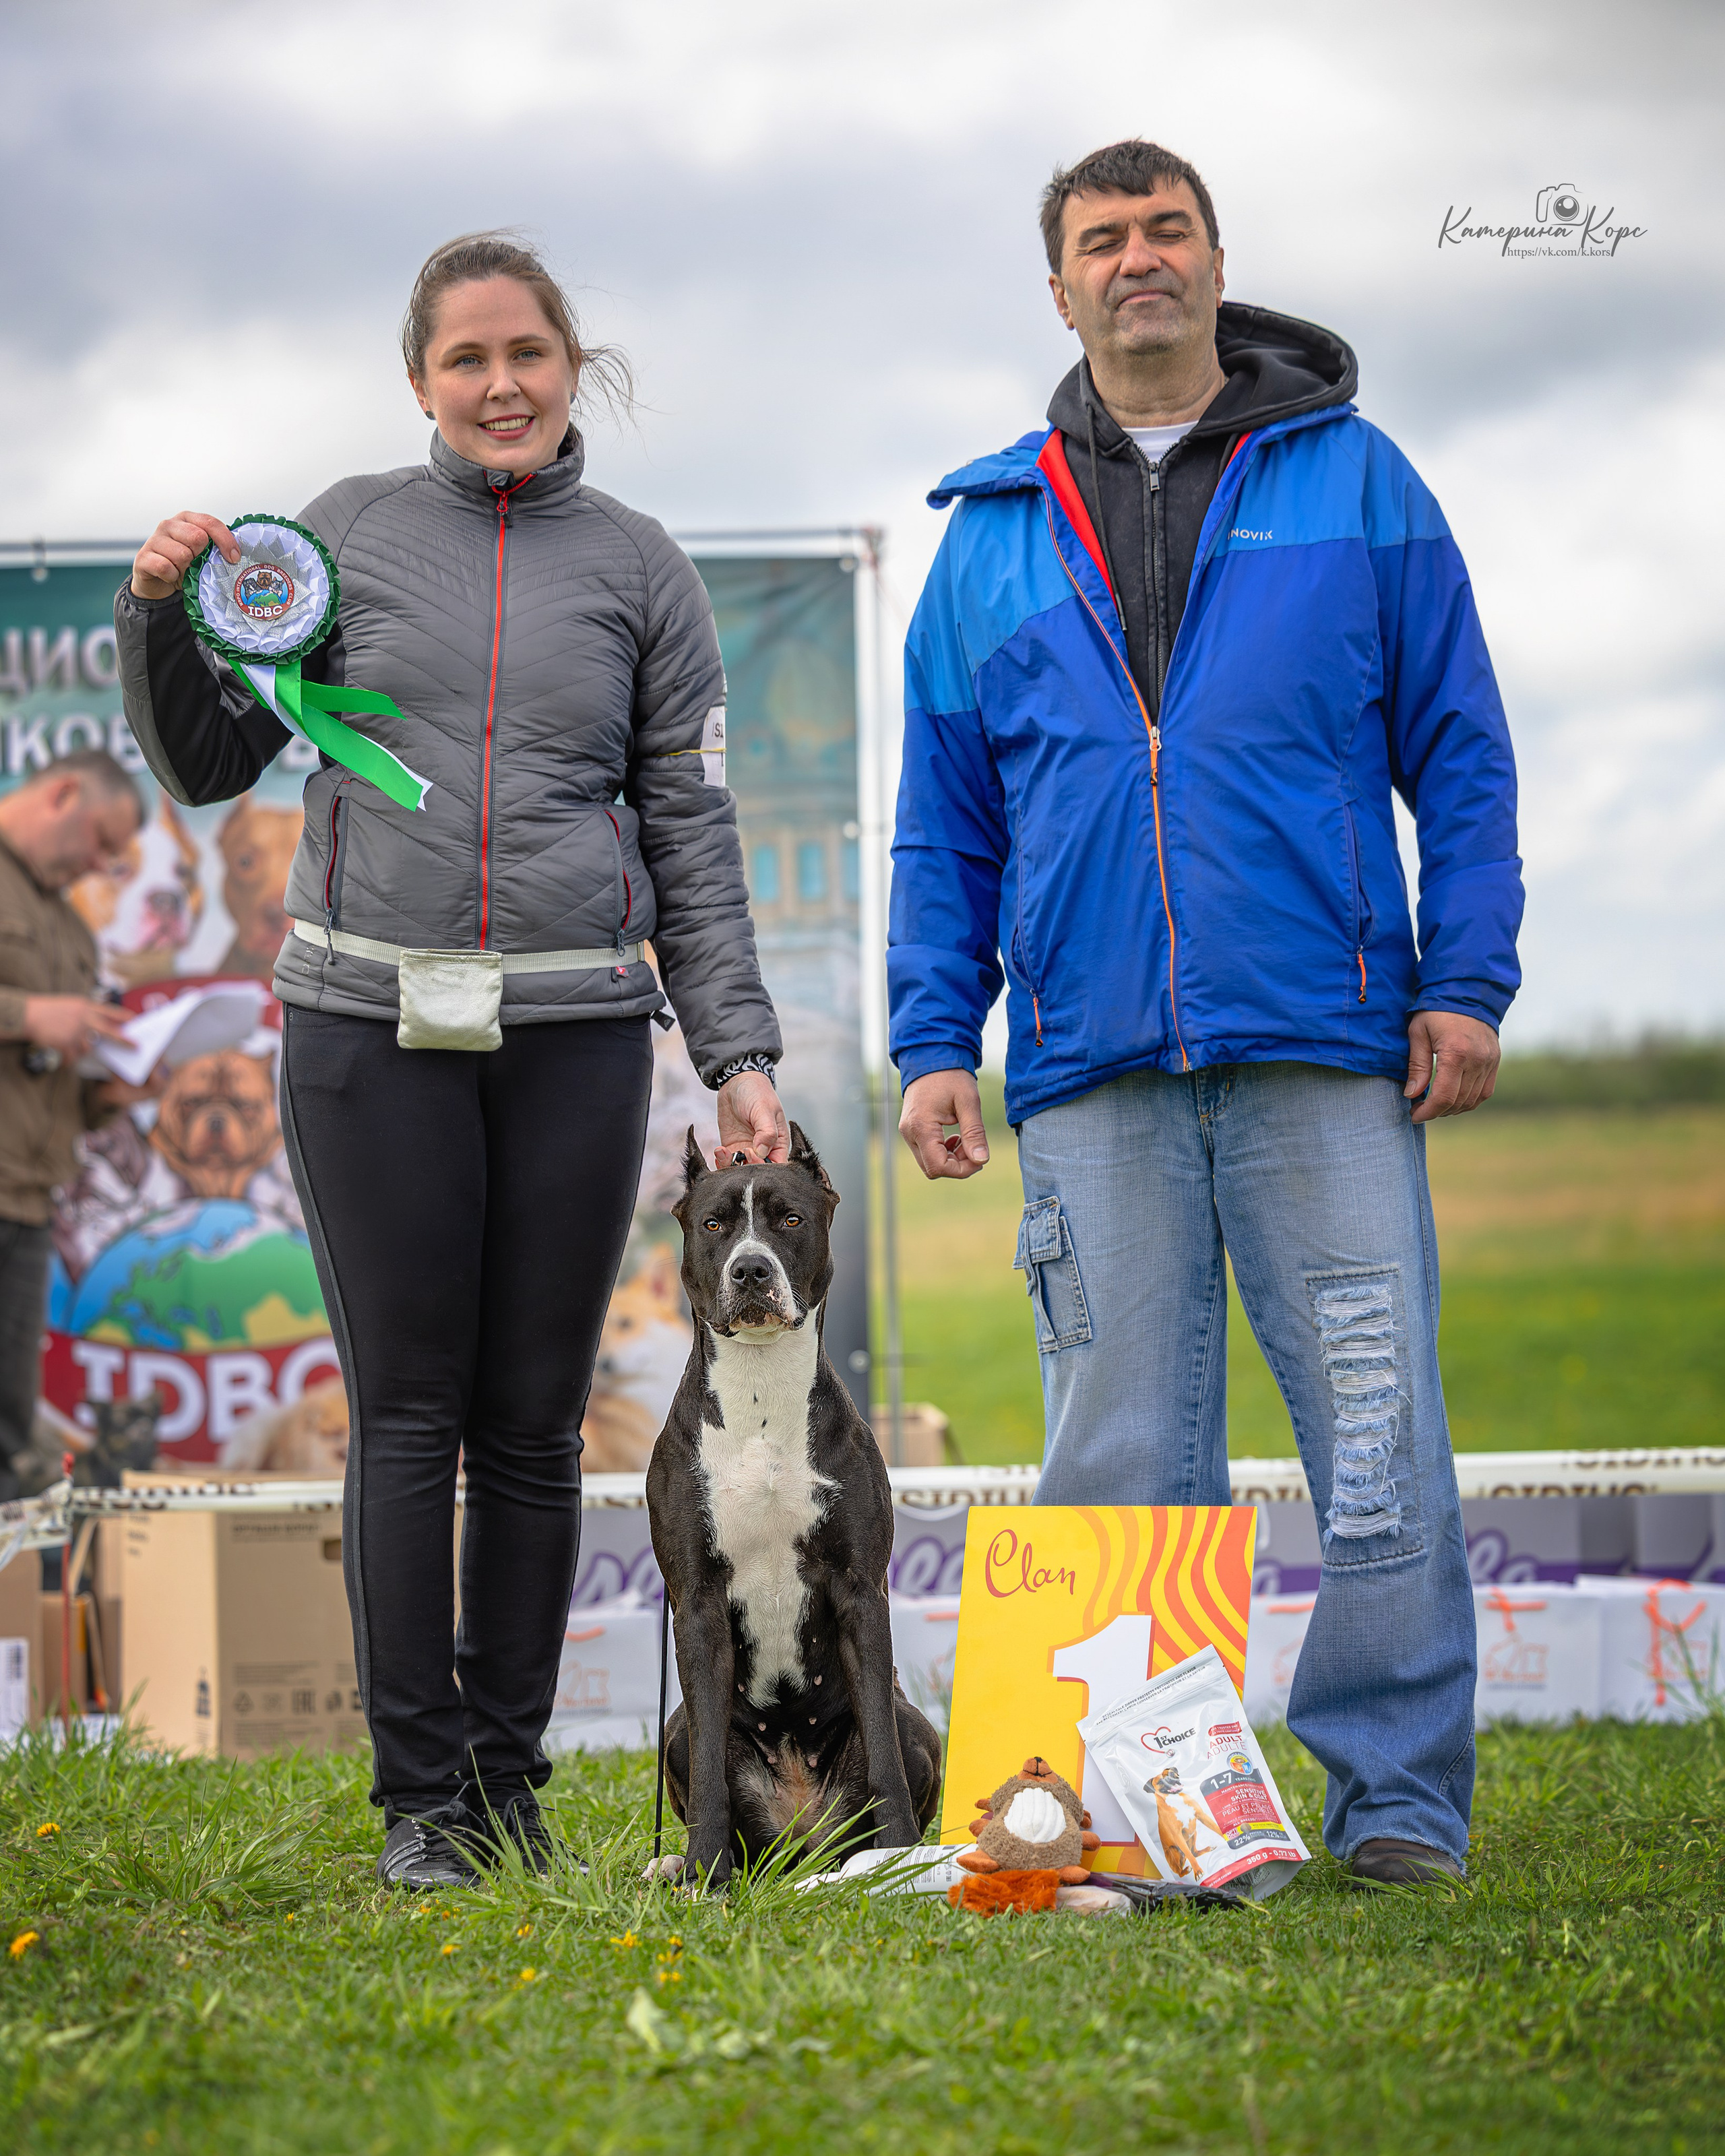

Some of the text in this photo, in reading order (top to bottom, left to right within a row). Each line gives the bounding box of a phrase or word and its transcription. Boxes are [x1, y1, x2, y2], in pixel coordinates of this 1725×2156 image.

[236, 565, 261, 592] INTERNATIONAL
[276, 569, 293, 591] BREEDERS
[247, 605, 283, 618] IDBC
[984, 1529, 1076, 1598] Clan
[1137, 1688, 1155, 1701] PROTECTS
[1175, 1674, 1183, 1682] AND
[1183, 1666, 1197, 1678] FLAVOR
[1136, 1692, 1158, 1706] CONSERVER
[1162, 1727, 1197, 1746] CHOICE
[1210, 1735, 1243, 1749] ADULT
[1207, 1741, 1247, 1760] ADULTE
[1210, 1772, 1232, 1789] 1-7
[1230, 1793, 1247, 1802] SKIN
[1235, 1787, 1267, 1796] SENSITIVE
[1222, 1806, 1241, 1817] PEAU
[1234, 1834, 1251, 1846] 22%
[1246, 1853, 1261, 1865] 350
